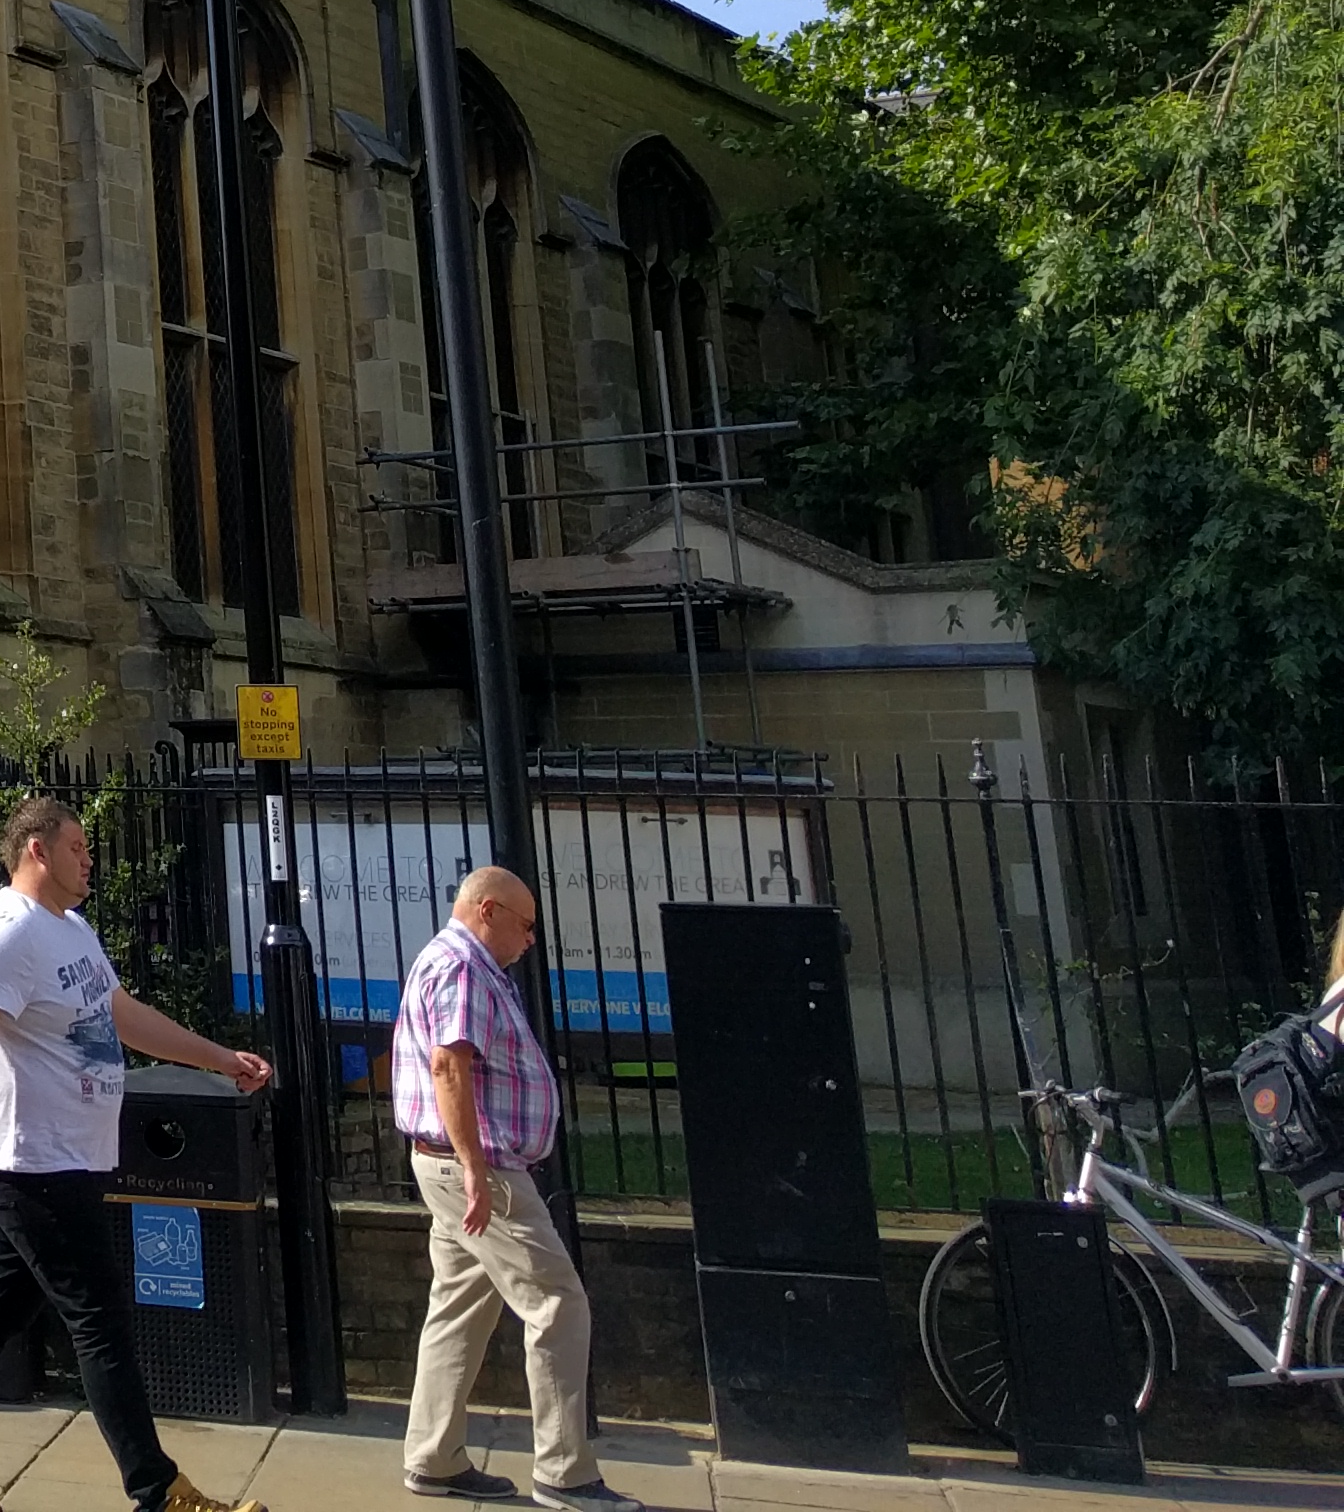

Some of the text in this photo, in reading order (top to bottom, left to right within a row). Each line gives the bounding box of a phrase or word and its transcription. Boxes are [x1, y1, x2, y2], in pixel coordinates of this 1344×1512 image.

[260, 707, 277, 717] No
[243, 720, 295, 730] stopping
[250, 732, 290, 744] except
[256, 744, 285, 754] taxis
[695, 876, 750, 894] GREA
[549, 944, 583, 959] 1am
[57, 955, 95, 990] SANTA
[126, 1174, 205, 1197] Recycling
